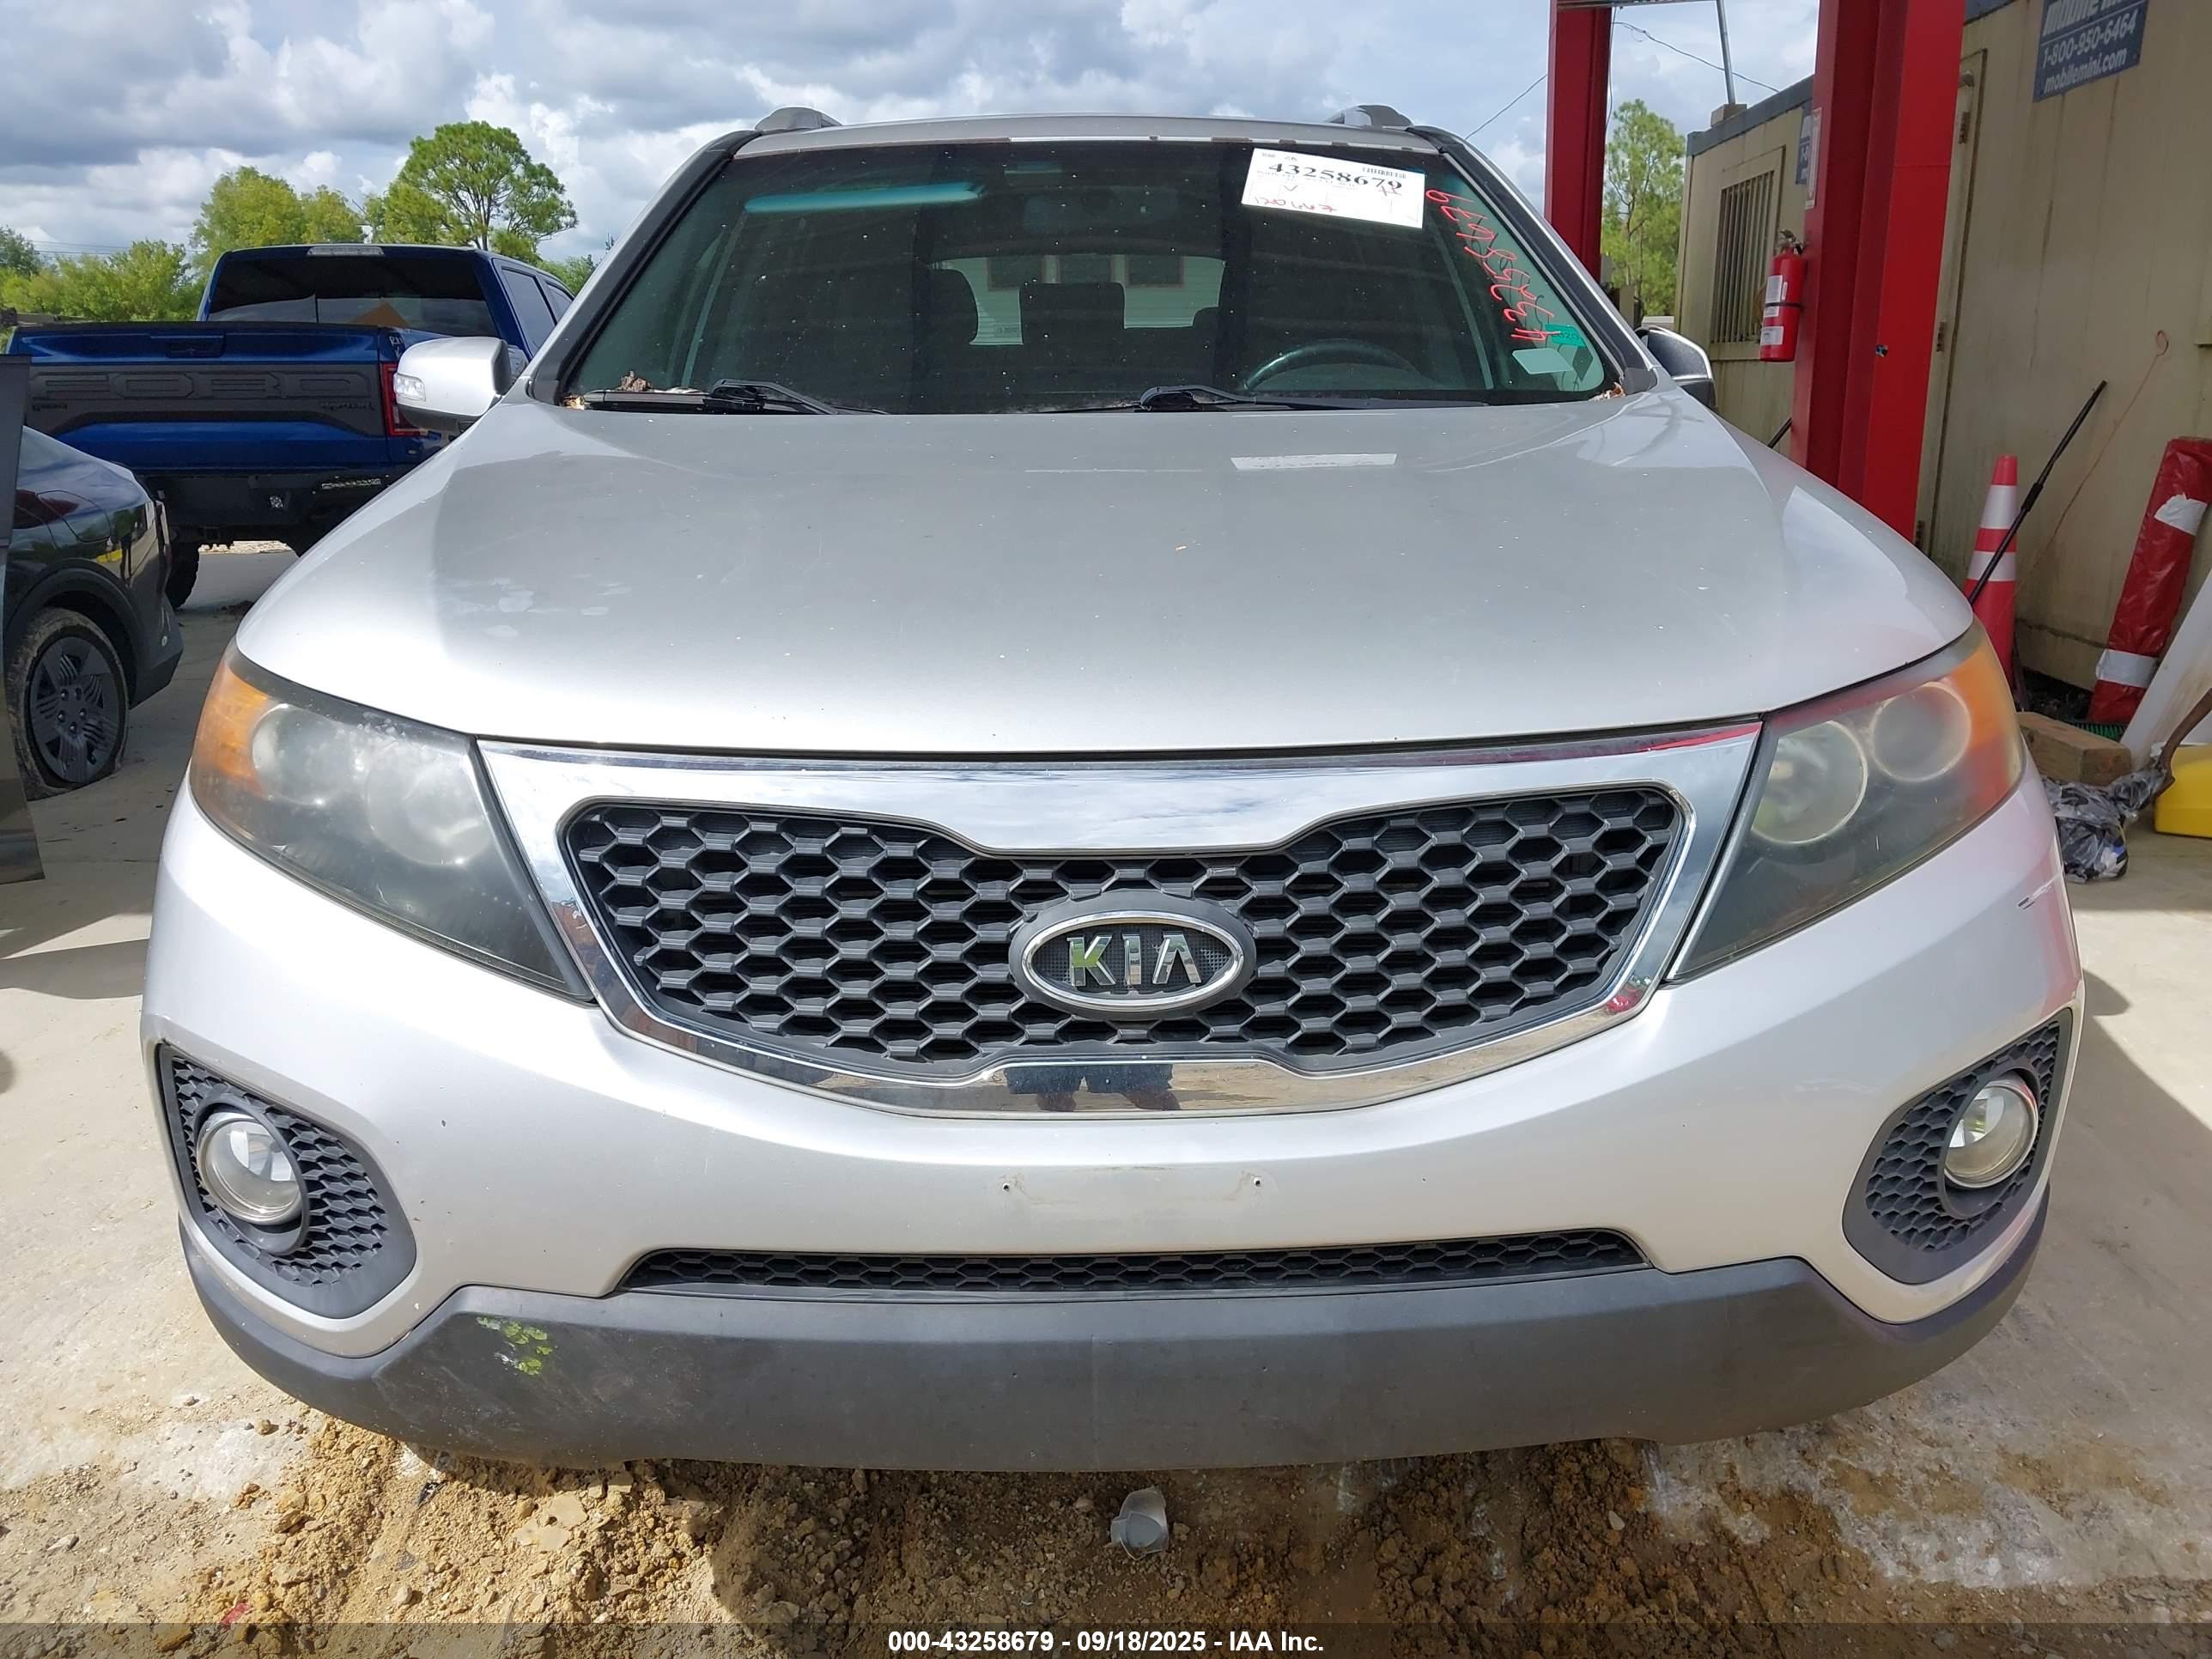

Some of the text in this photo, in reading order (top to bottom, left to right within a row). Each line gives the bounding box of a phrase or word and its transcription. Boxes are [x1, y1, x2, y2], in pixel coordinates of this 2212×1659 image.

[2043, 9, 2138, 69] 1-800-950-6464
[2044, 48, 2127, 94] mobilemini.com
[1268, 162, 1402, 190] 43258679
[1425, 190, 1561, 341] 43258679
[30, 372, 371, 399] FORD
[1066, 933, 1201, 987] KIA
